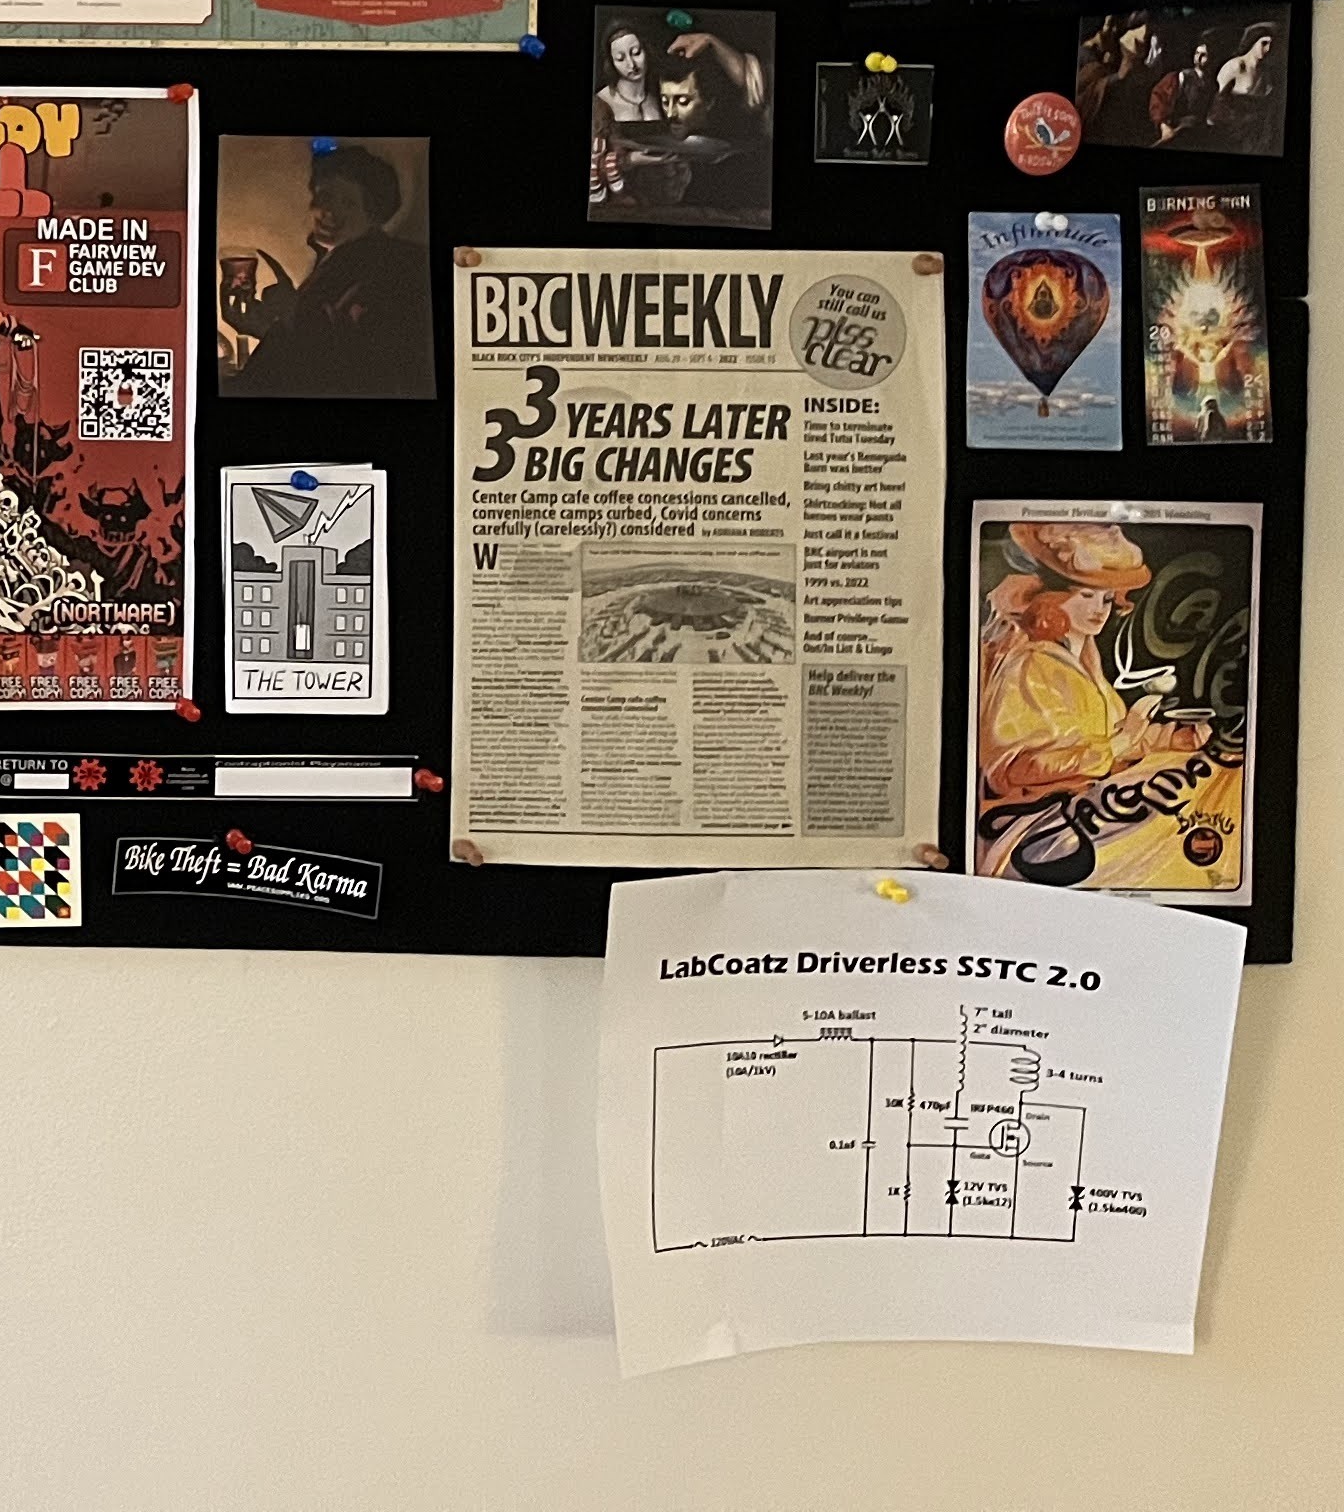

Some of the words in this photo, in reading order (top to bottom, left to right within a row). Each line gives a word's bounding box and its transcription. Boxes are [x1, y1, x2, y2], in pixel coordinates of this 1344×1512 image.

[37, 220, 113, 241] MADE
[121, 219, 147, 240] IN
[69, 244, 156, 260] FAIRVIEW
[69, 260, 127, 276] GAME
[131, 261, 165, 276] DEV
[69, 277, 116, 293] CLUB
[829, 284, 854, 299] You
[856, 291, 880, 305] can
[476, 277, 568, 345] BRC
[576, 273, 783, 347] WEEKLY
[817, 297, 844, 313] still
[846, 303, 870, 318] call
[872, 309, 887, 321] us
[524, 366, 560, 438] 3
[566, 404, 671, 439] YEARS
[683, 405, 791, 440] LATER
[804, 397, 880, 414] INSIDE:
[473, 409, 516, 482] 3
[525, 448, 583, 482] BIG
[596, 448, 753, 483] CHANGES
[472, 491, 517, 506] Center
[521, 491, 557, 509] Camp
[561, 491, 589, 506] cafe
[594, 491, 634, 506] coffee
[638, 491, 717, 506] concessions
[722, 491, 791, 508] cancelled,
[472, 507, 555, 521] convenience
[560, 509, 602, 524] camps
[608, 507, 656, 523] curbed,
[661, 507, 698, 521] Covid
[702, 509, 761, 521] concerns
[472, 523, 529, 539] carefully
[534, 523, 615, 539] (carelessly?)
[620, 523, 694, 537] considered
[54, 602, 174, 624] (NORTWARE)
[245, 669, 284, 691] THE
[292, 670, 362, 692] TOWER
[50, 759, 68, 771] TO
[125, 844, 167, 872] Bike
[168, 845, 223, 878] Theft
[248, 854, 292, 883] Bad
[297, 864, 369, 899] Karma
[660, 953, 789, 980] LabCoatz
[796, 953, 947, 976] Driverless
[957, 957, 1037, 984] SSTC
[1046, 966, 1102, 992] 2.0
[839, 1009, 876, 1021] ballast
[992, 1007, 1012, 1020] tall
[990, 1025, 1049, 1039] diameter
[1069, 1074, 1103, 1084] turns
